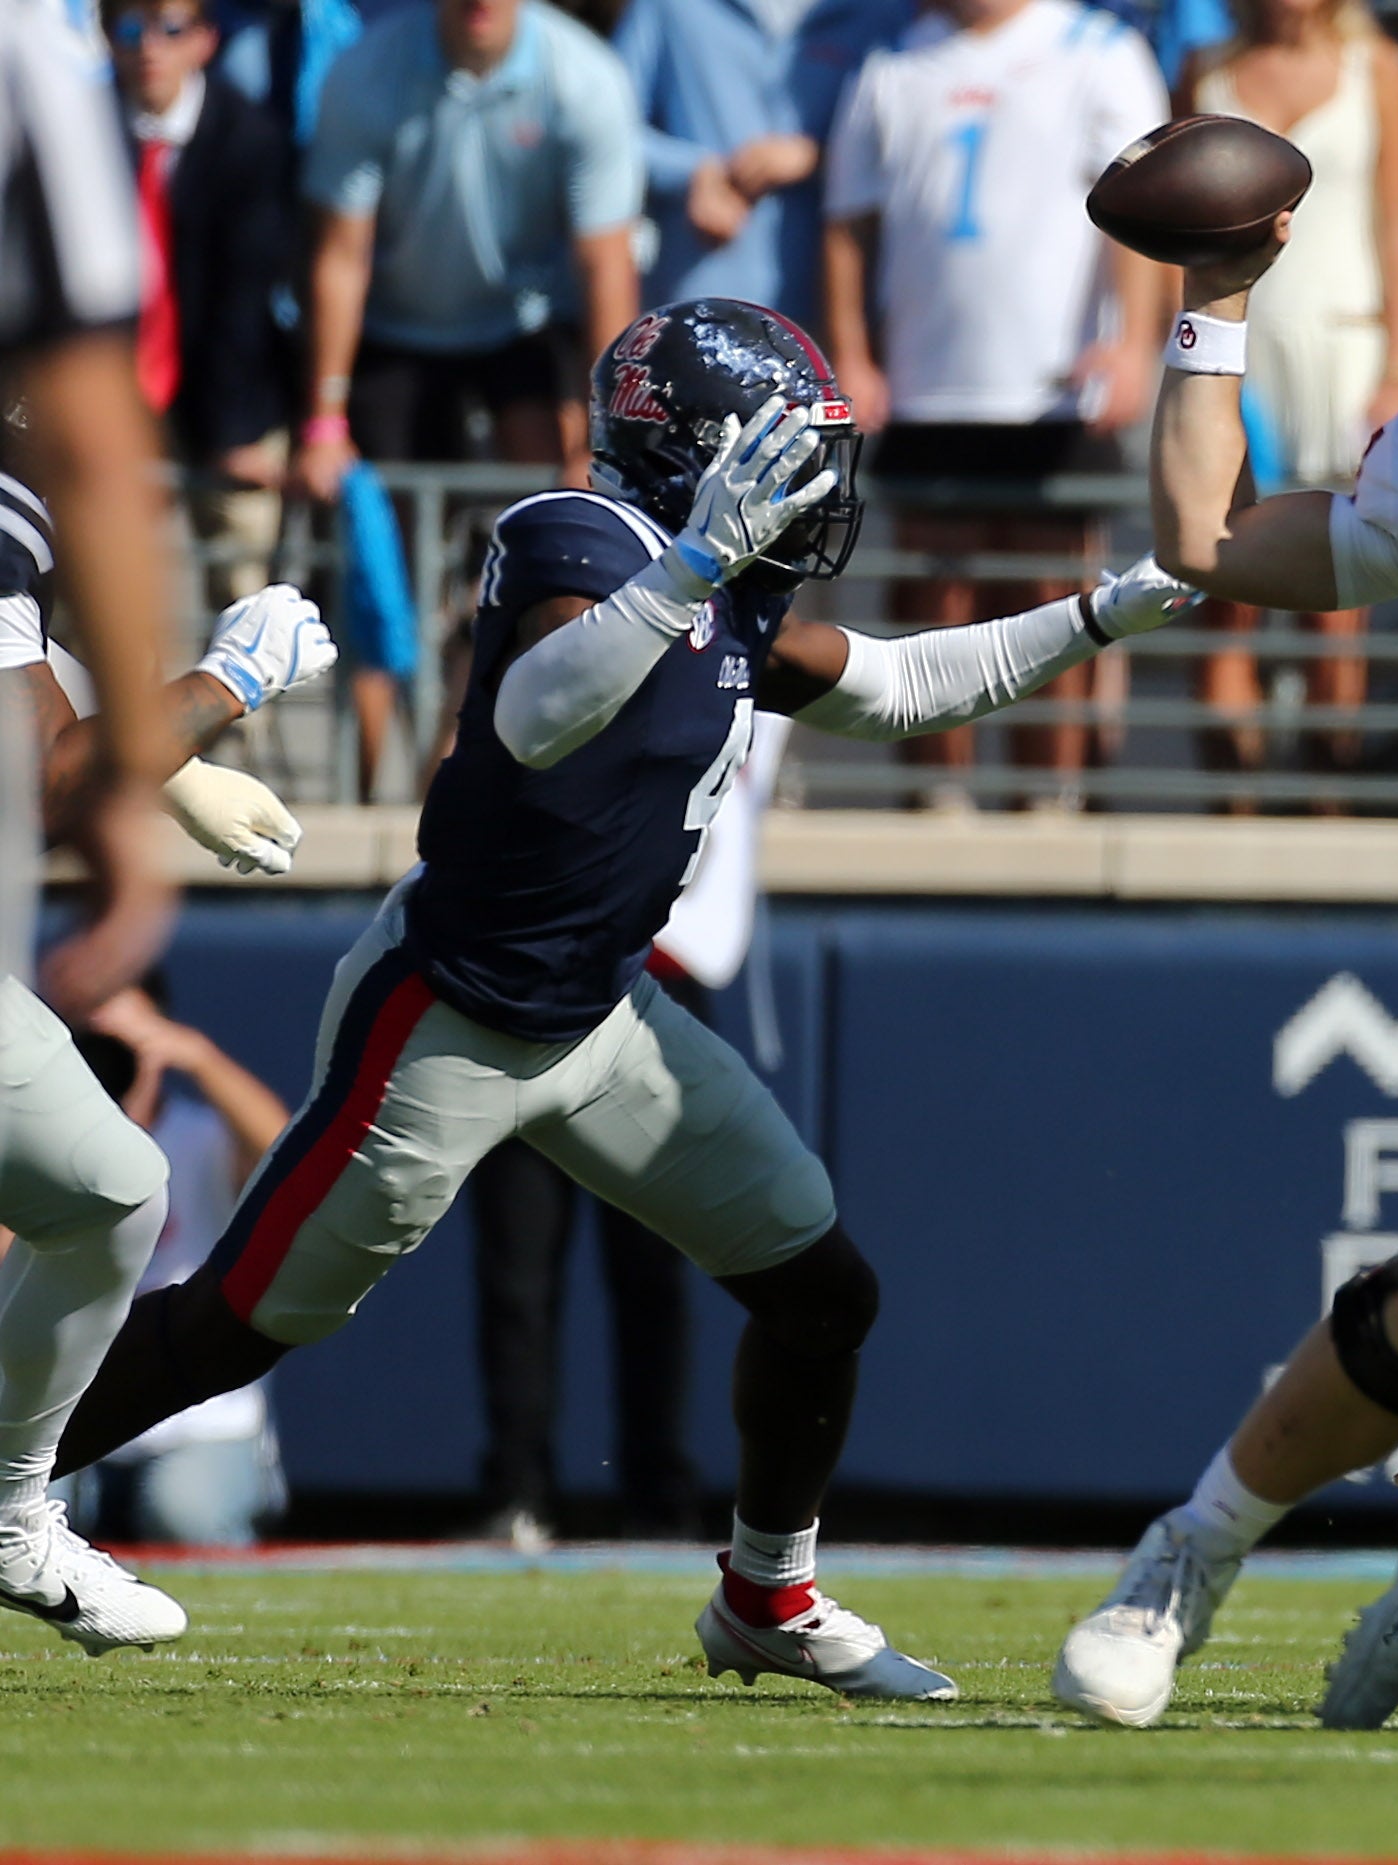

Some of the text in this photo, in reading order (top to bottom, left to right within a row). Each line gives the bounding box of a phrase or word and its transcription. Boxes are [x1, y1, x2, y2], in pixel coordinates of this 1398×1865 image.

[946, 120, 986, 240] 1
[613, 314, 671, 360] Ole
[609, 363, 672, 424] Miss
[679, 697, 755, 887] 4
